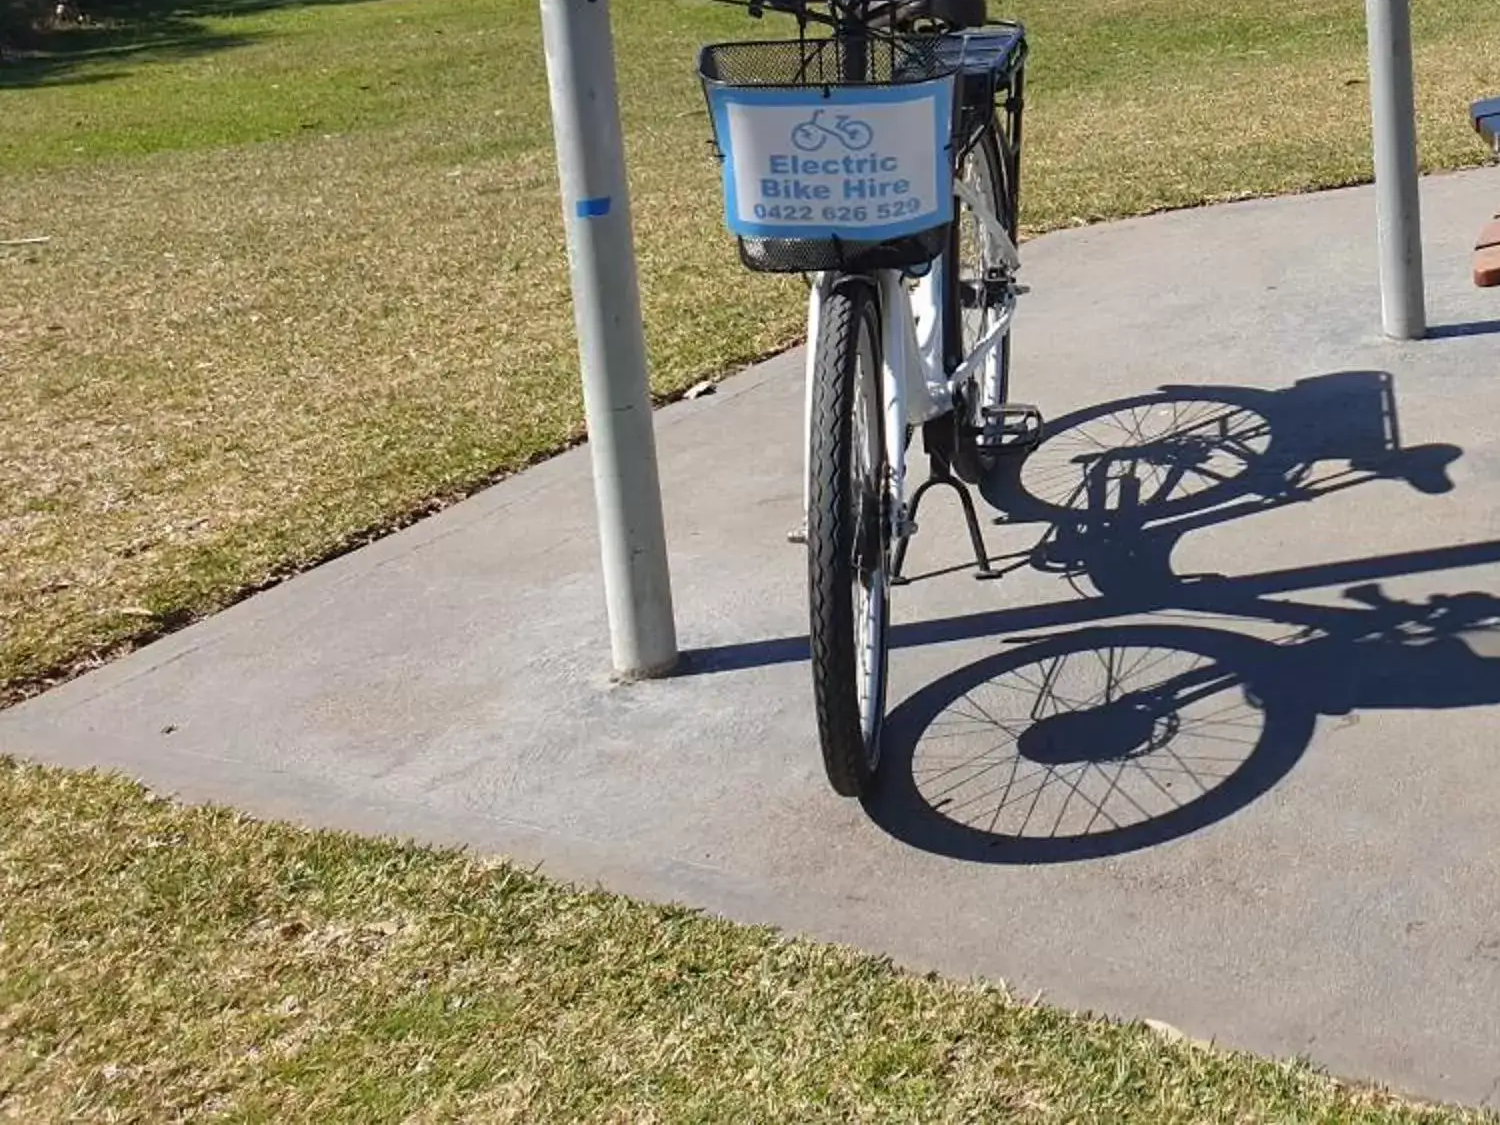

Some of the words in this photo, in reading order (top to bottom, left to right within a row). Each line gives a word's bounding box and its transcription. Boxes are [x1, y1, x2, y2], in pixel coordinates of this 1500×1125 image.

[769, 153, 898, 175] Electric
[760, 178, 831, 200] Bike
[843, 177, 910, 200] Hire
[753, 203, 813, 221] 0422
[821, 205, 867, 222] 626
[877, 197, 921, 219] 529
